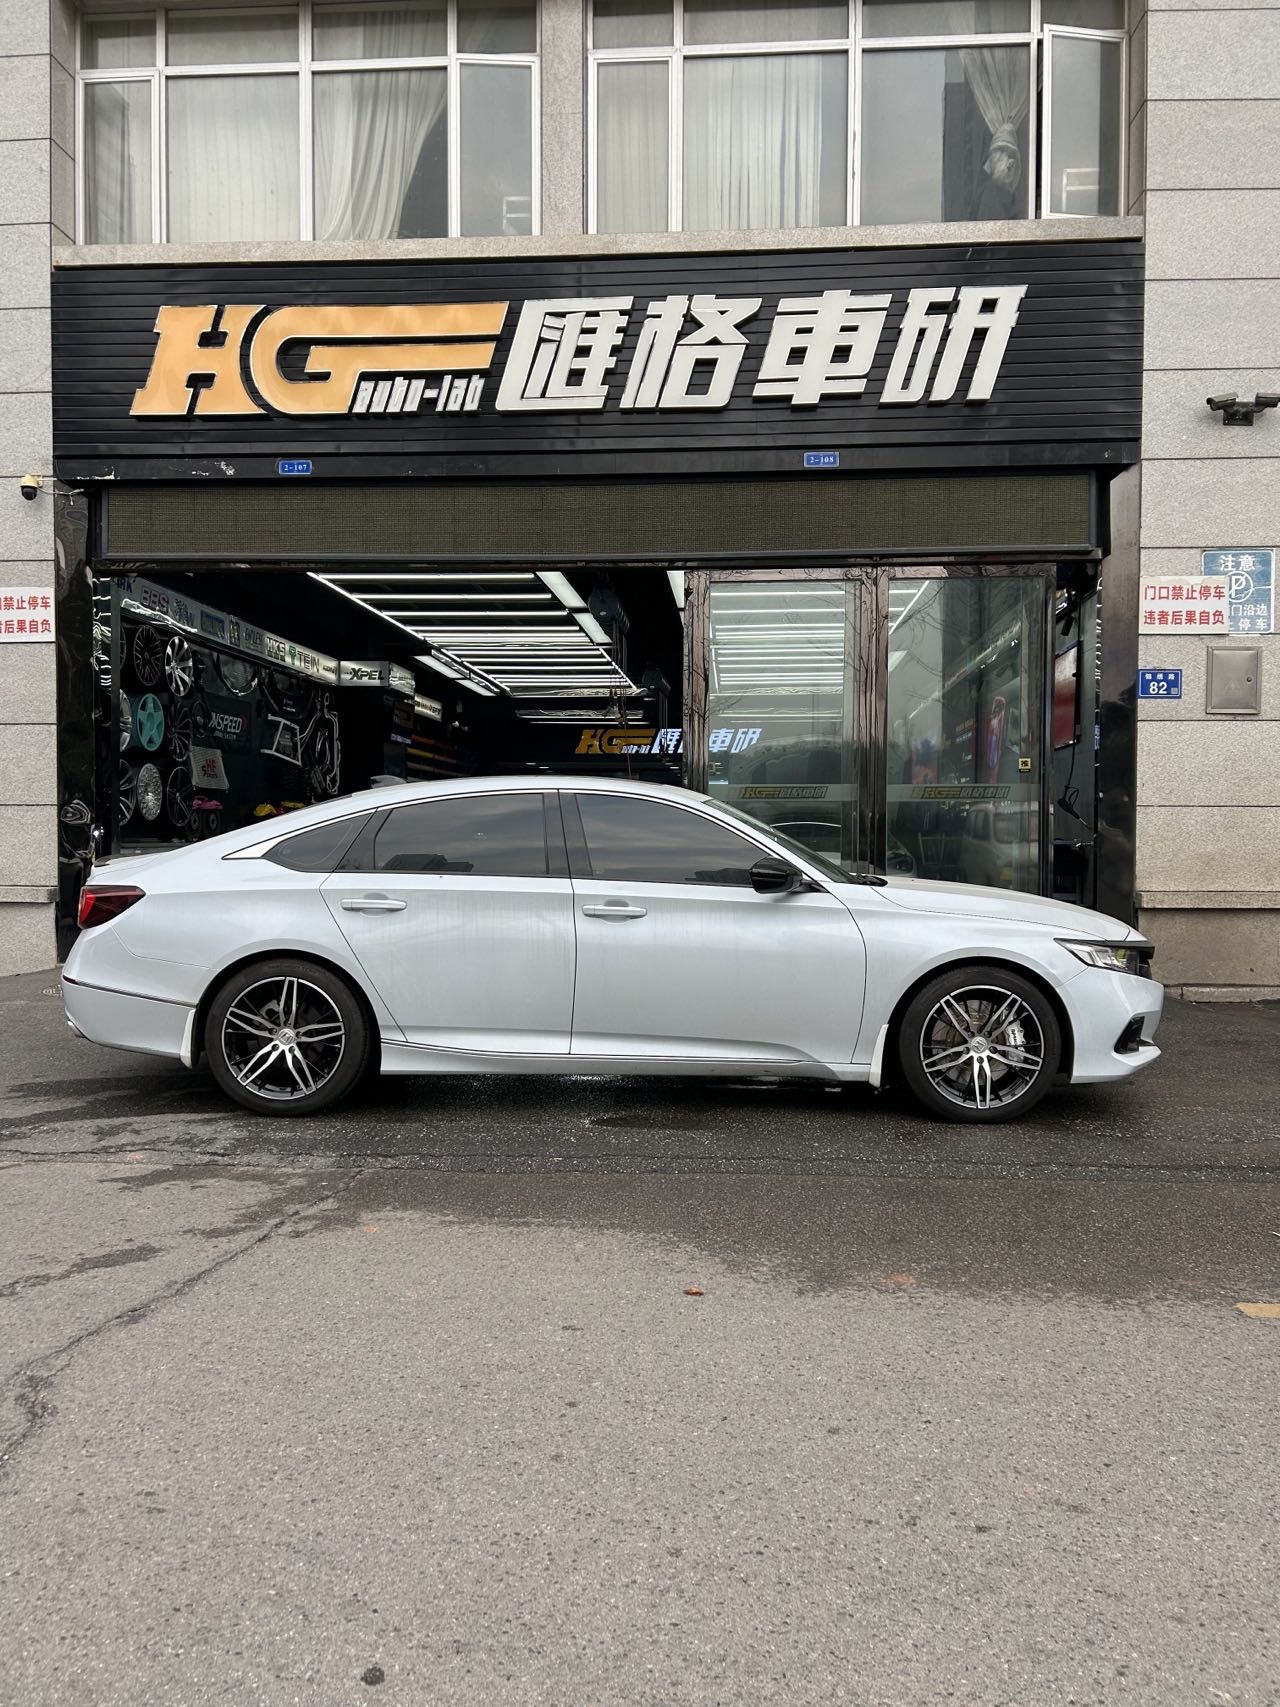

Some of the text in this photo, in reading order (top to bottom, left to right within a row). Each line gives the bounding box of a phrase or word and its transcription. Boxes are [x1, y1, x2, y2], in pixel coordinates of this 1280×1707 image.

[351, 374, 486, 413] auto-lab
[1219, 554, 1255, 571] 注意
[1144, 585, 1226, 600] 门口禁止停车
[0, 596, 51, 610] 禁止停车
[1143, 610, 1225, 625] 违者后果自负
[0, 619, 51, 633] 后果自负
[297, 650, 320, 673] TEIN
[349, 668, 385, 680] XPEL
[1149, 681, 1167, 694] 82
